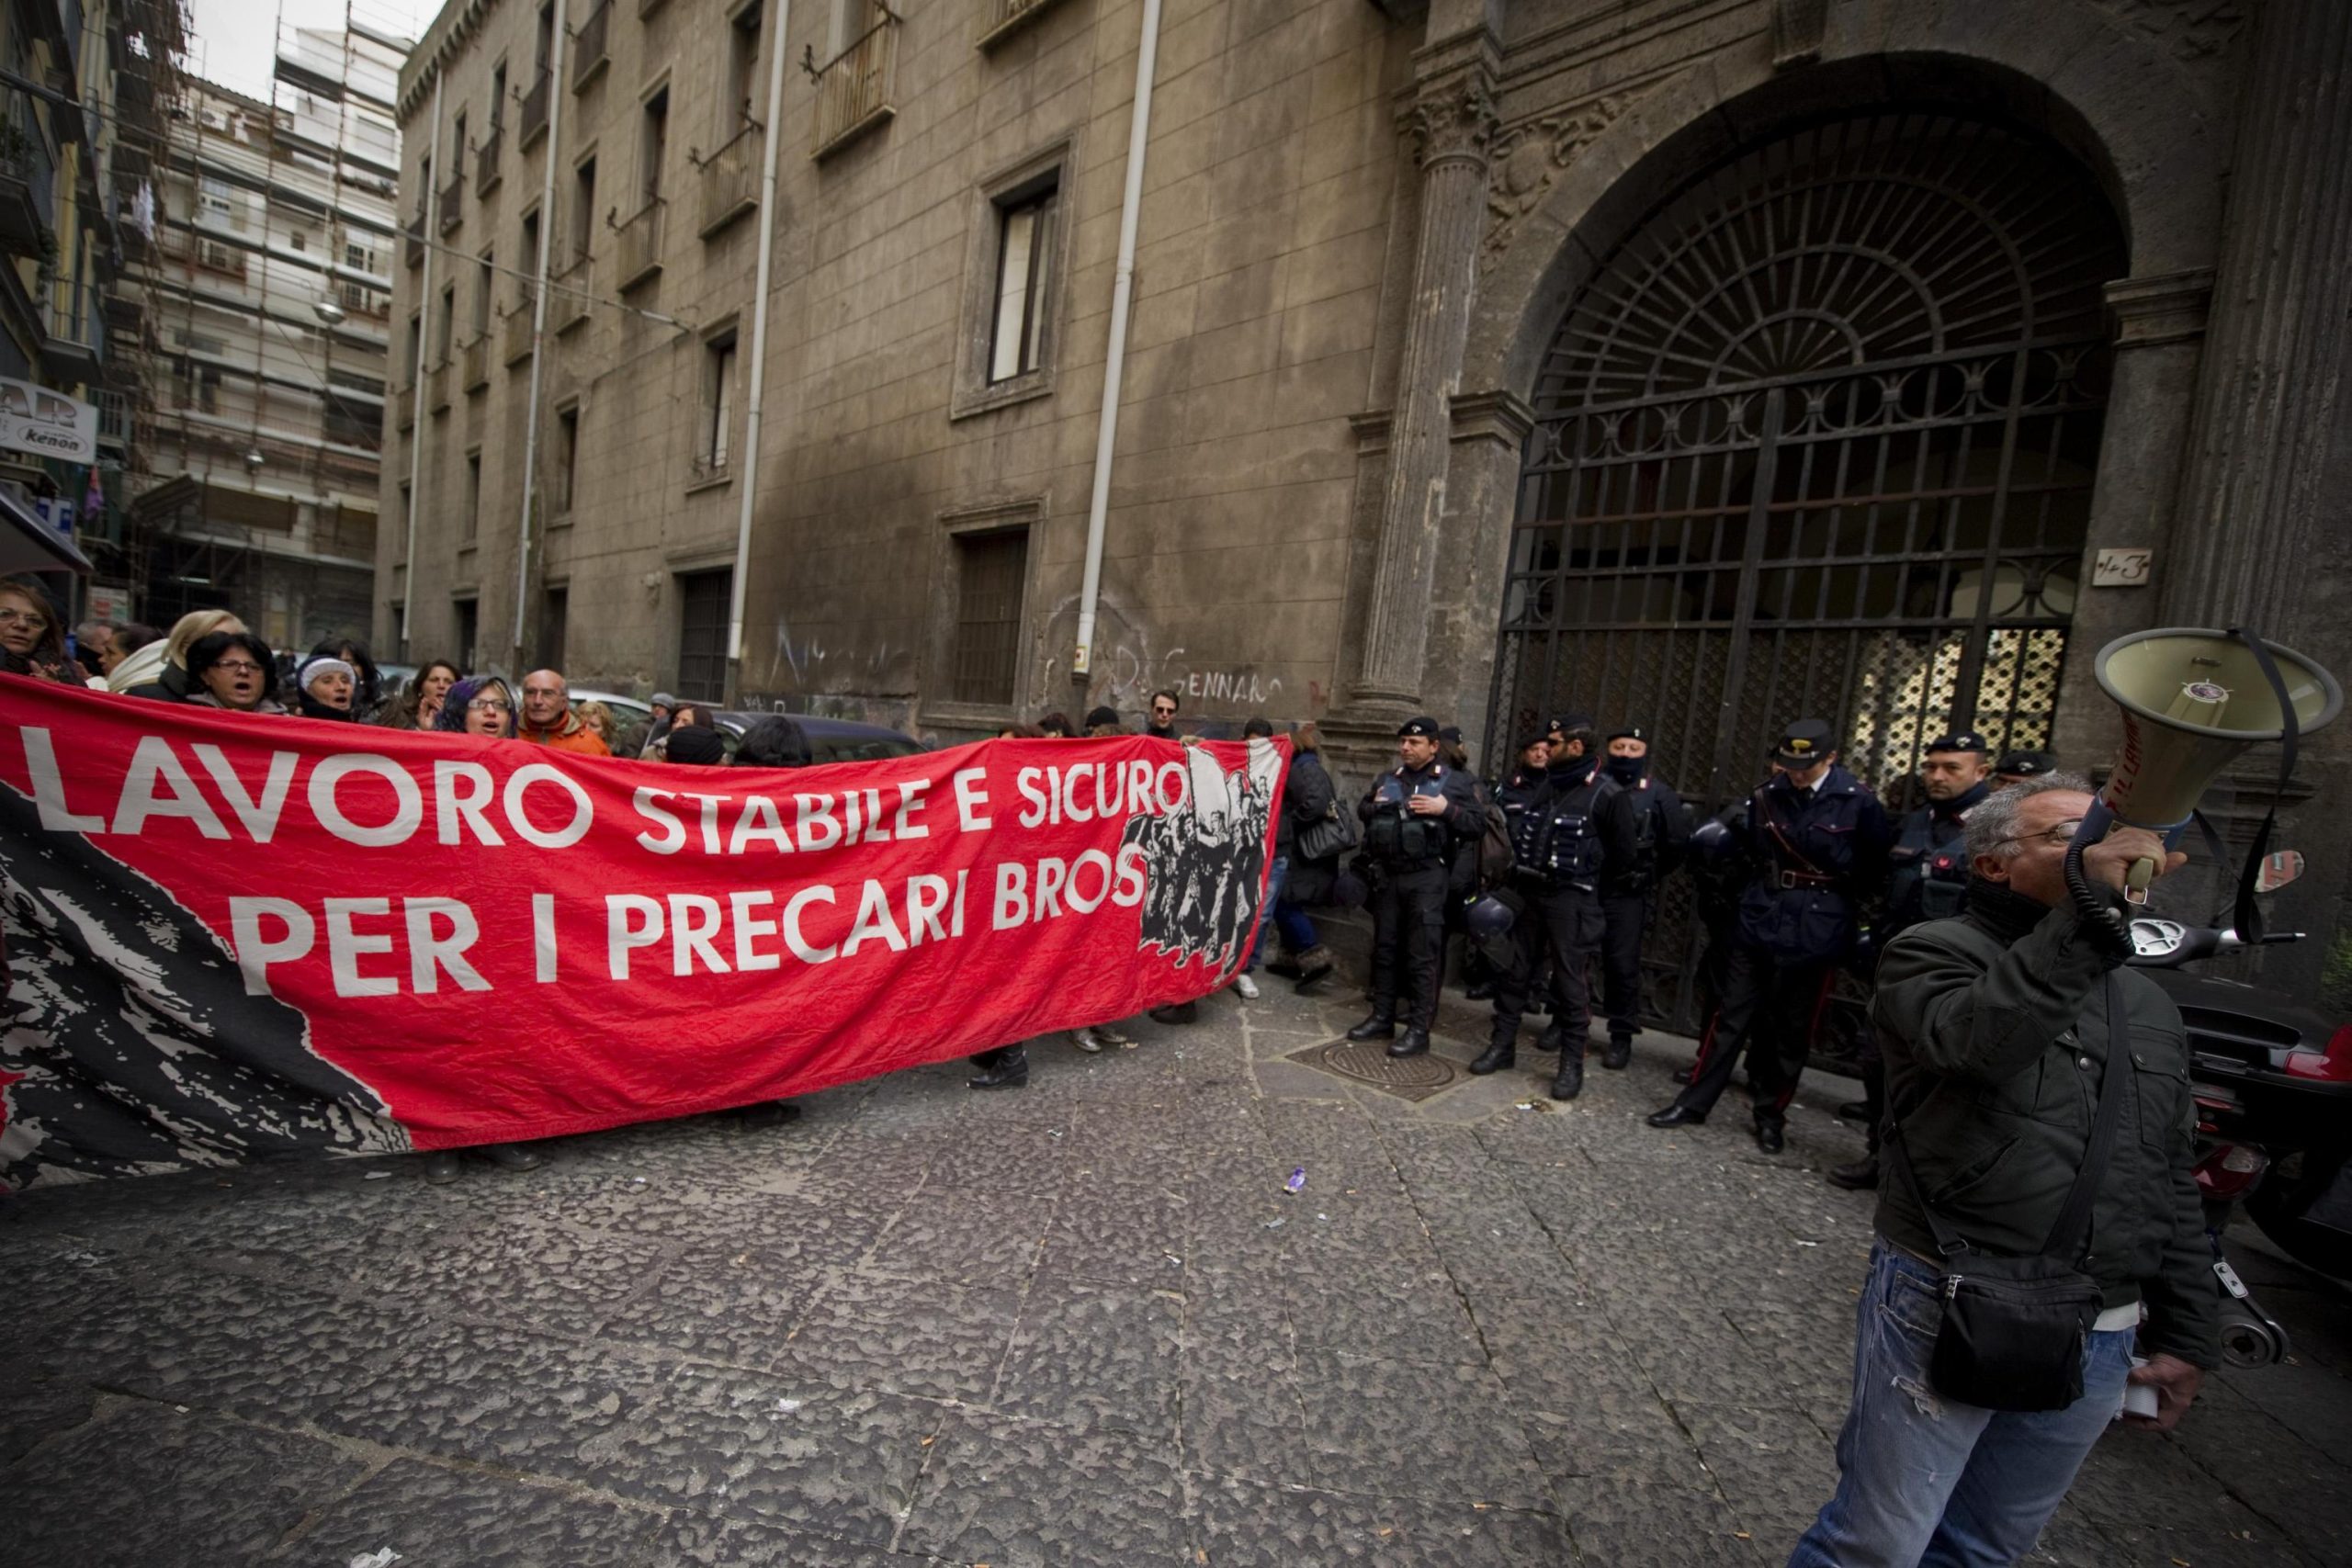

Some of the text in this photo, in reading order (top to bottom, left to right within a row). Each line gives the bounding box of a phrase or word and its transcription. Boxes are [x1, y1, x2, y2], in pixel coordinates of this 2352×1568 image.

[26, 428, 80, 451] kenon
[20, 726, 1190, 854] LAVORO STABILE E SICURO
[229, 844, 1147, 998] PER I PRECARI BROS
